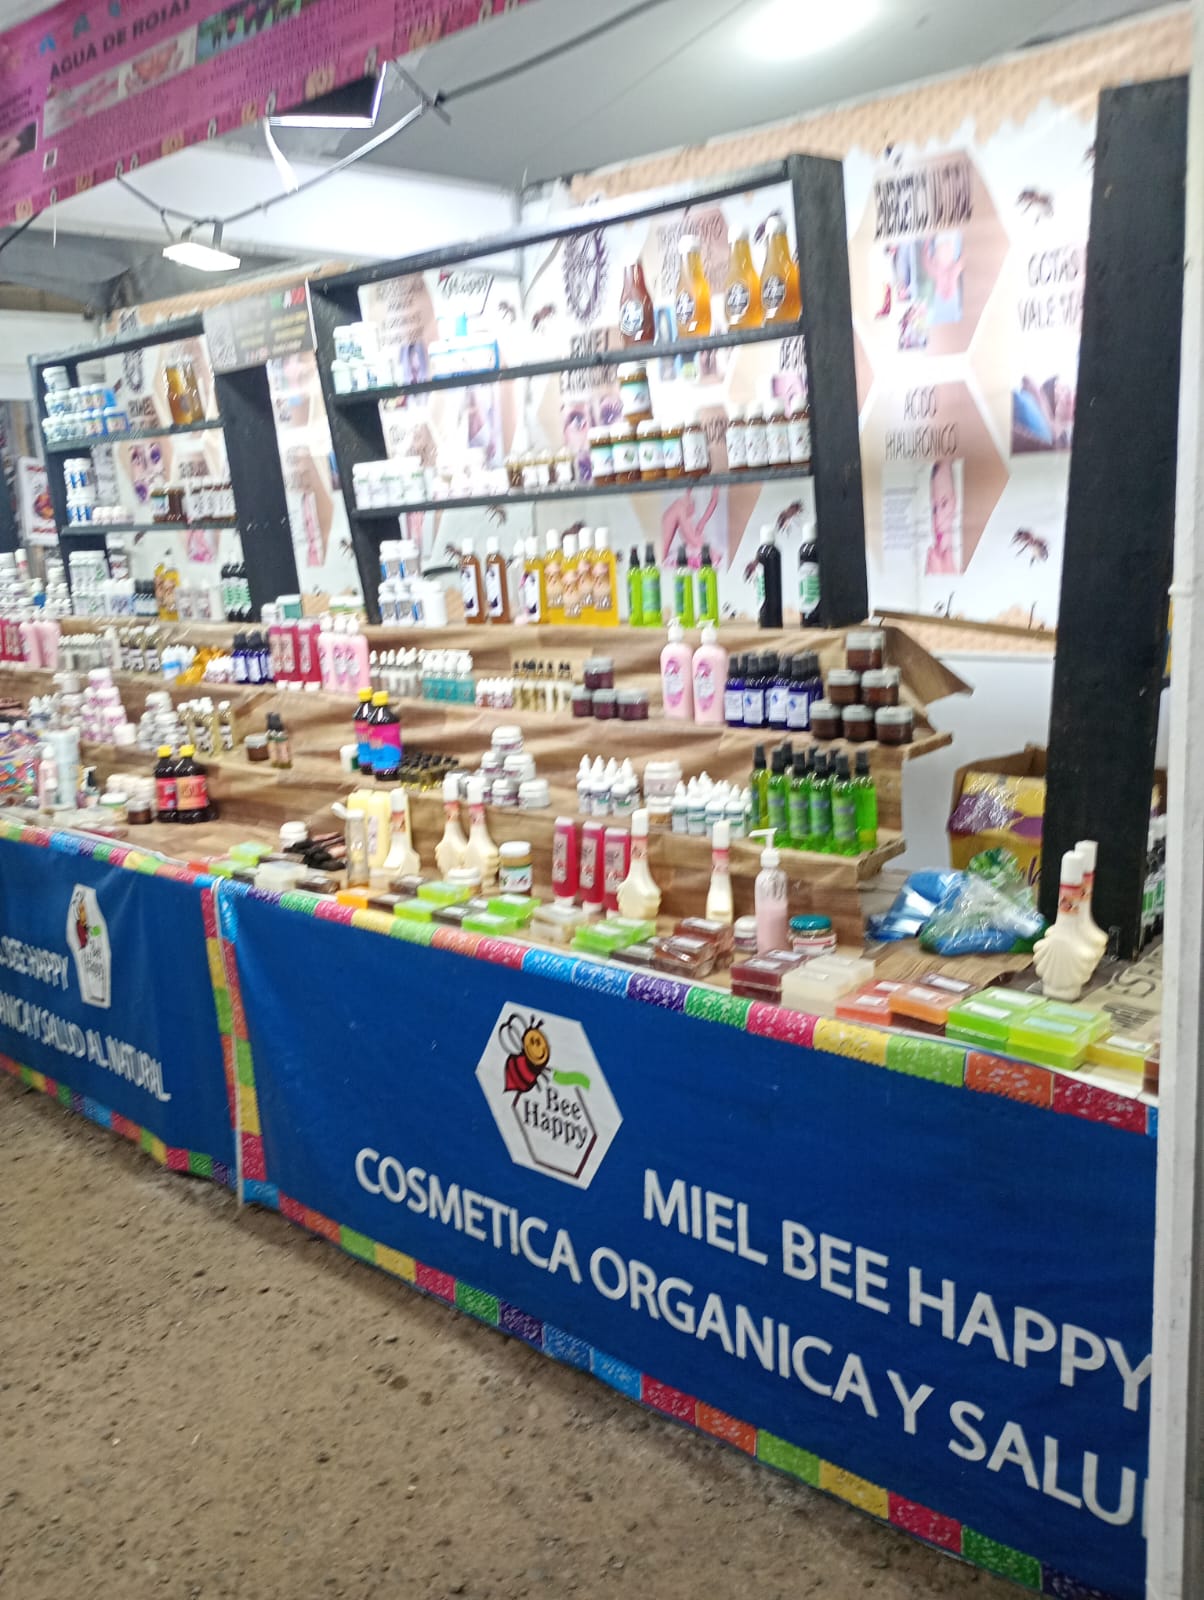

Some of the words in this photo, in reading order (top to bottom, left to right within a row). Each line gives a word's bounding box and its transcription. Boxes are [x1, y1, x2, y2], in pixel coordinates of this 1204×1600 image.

[50, 42, 98, 82] AGUA
[102, 26, 128, 53] DE
[523, 1100, 588, 1150] Happy
[545, 1087, 582, 1121] Bee
[643, 1168, 769, 1267] MIEL
[782, 1220, 891, 1315] BEE
[908, 1266, 1153, 1413] HAPPY
[355, 1147, 583, 1285] COSMETICA
[589, 1246, 879, 1419] ORGANICA
[886, 1370, 935, 1436] Y
[948, 1400, 1150, 1539] SALU
